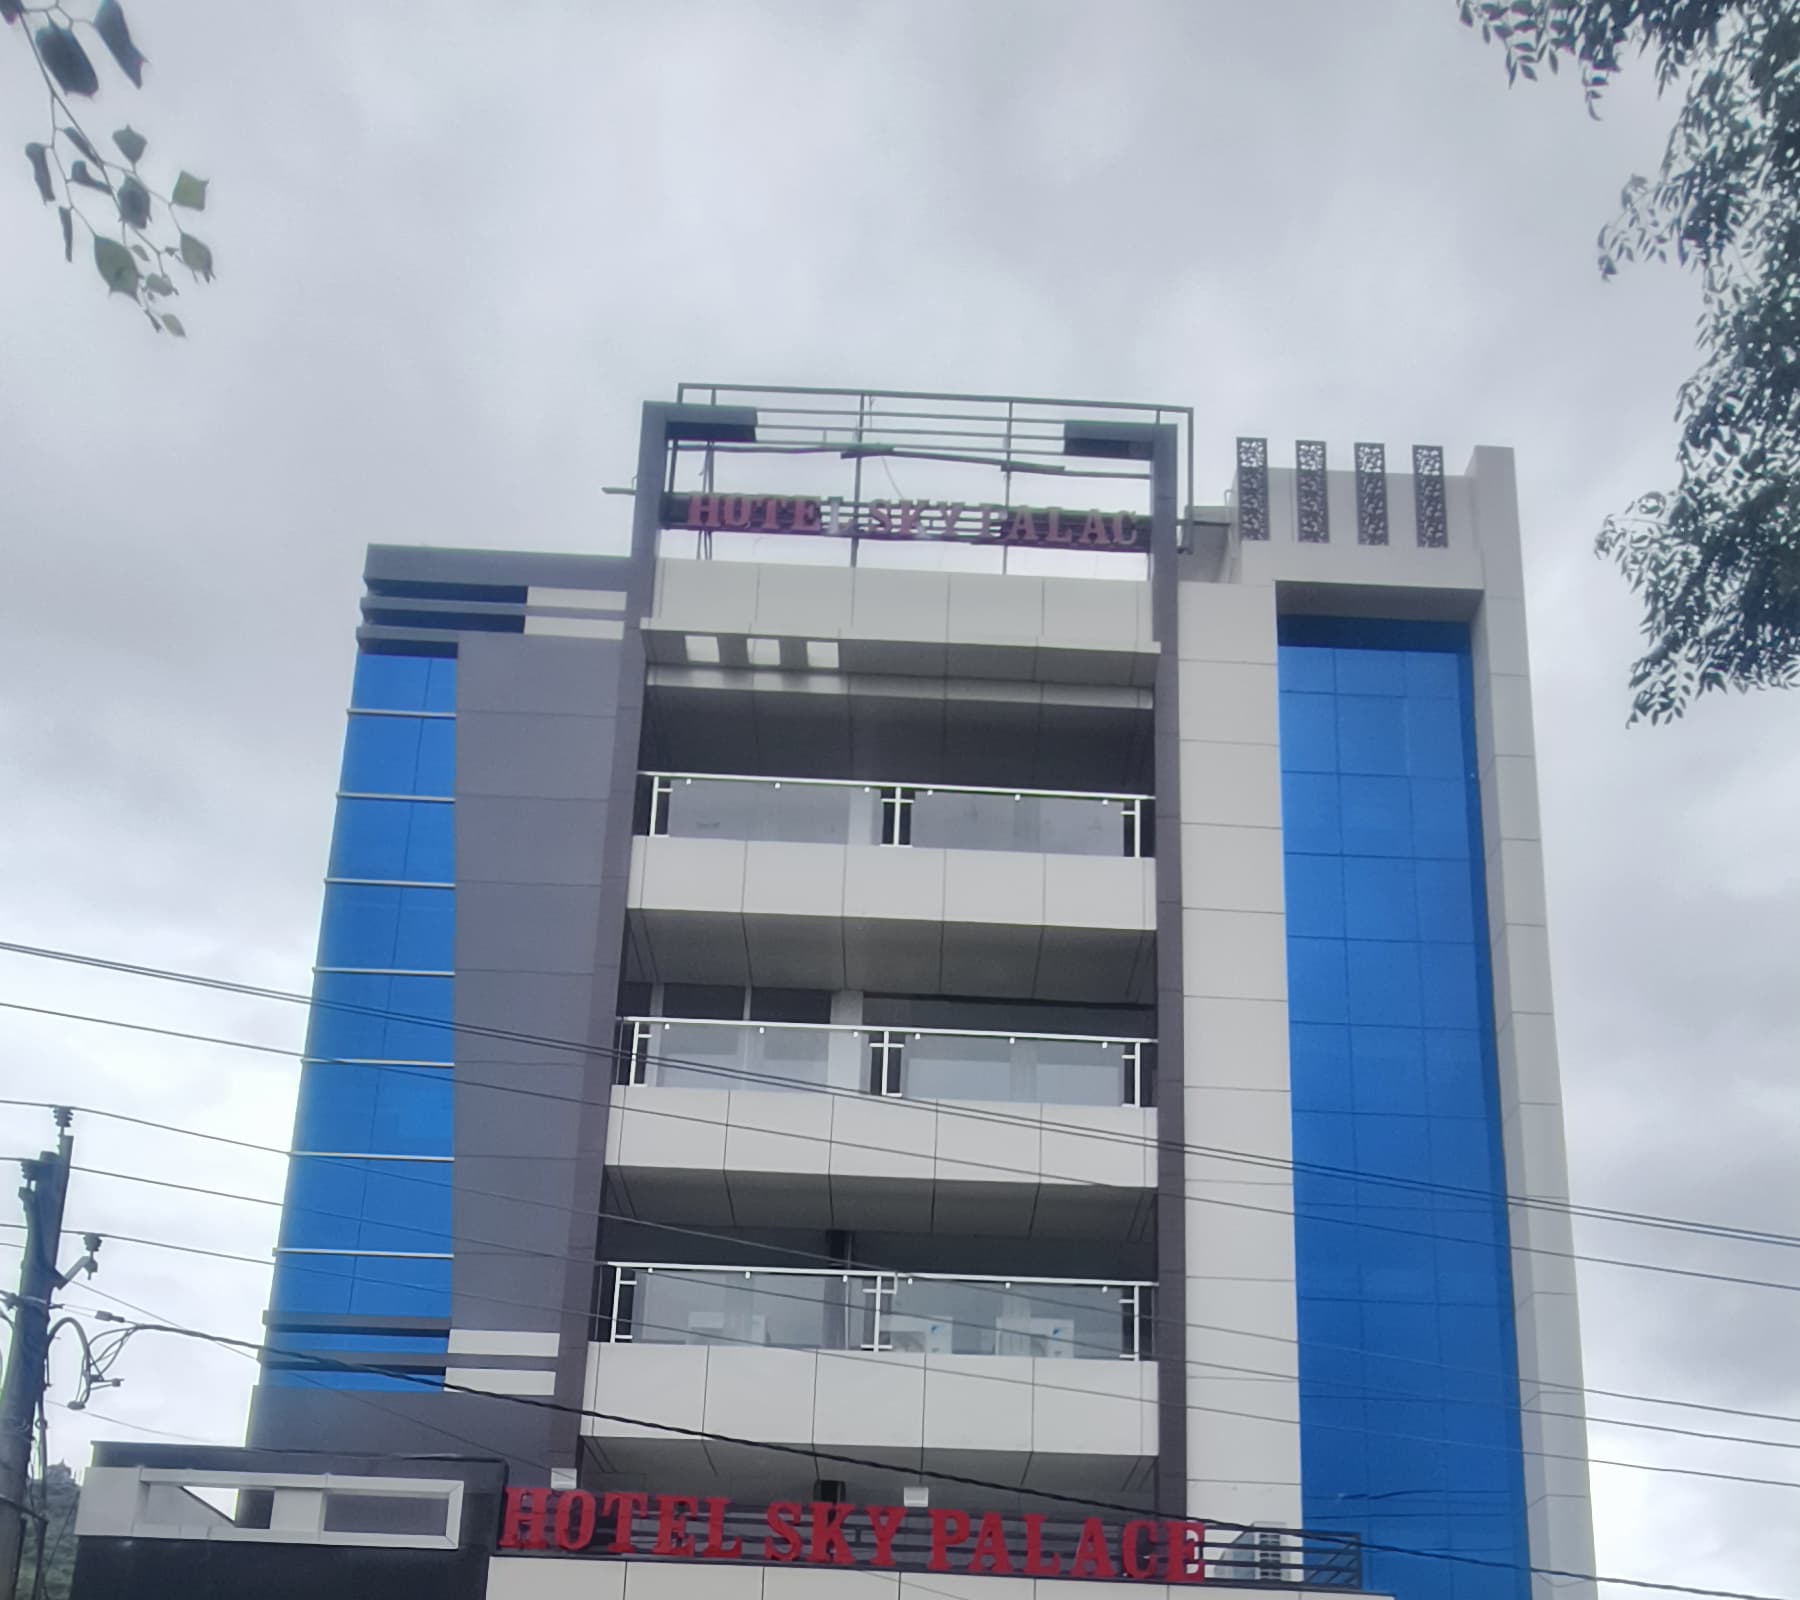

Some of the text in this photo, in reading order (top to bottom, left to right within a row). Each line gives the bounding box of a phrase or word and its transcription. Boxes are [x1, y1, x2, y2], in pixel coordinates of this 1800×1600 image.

[687, 493, 1138, 546] HOTEL SKY PALAC
[498, 1487, 1205, 1582] HOTEL SKY PALACE
